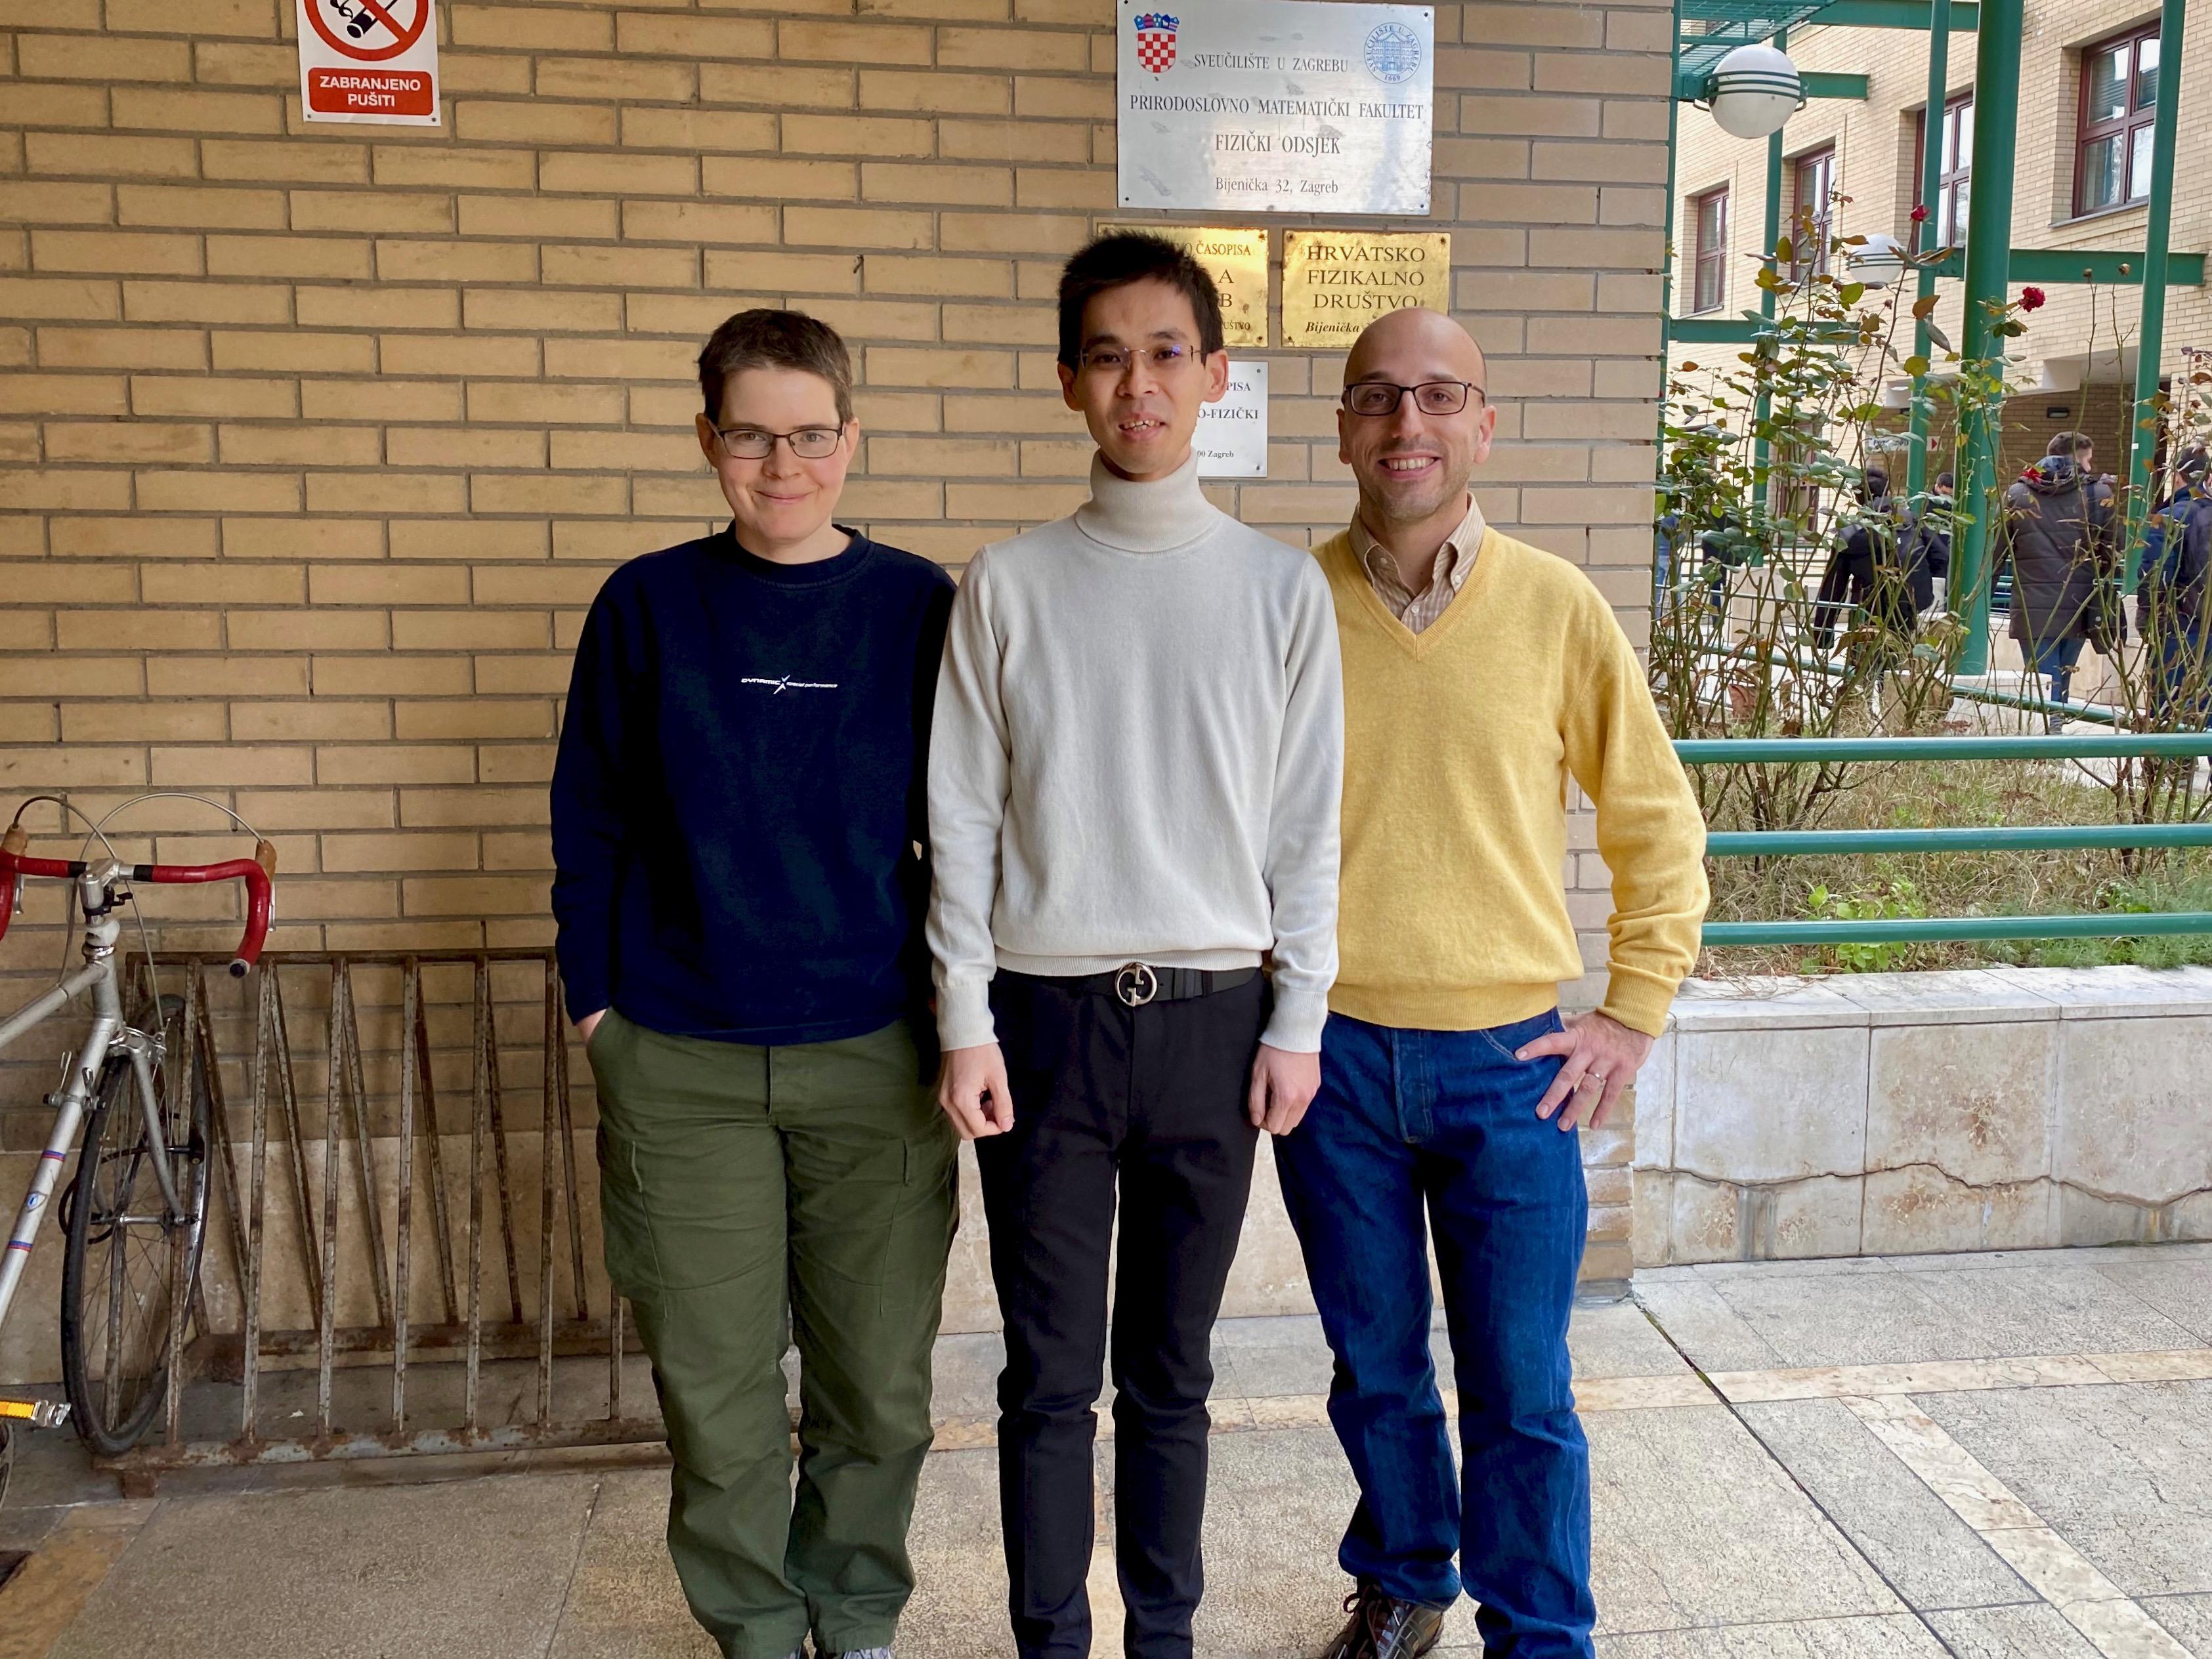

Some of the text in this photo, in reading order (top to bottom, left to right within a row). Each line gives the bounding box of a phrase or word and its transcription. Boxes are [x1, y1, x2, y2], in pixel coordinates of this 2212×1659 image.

[1195, 51, 1349, 73] SVEUČILIŠTE U ZAGREBU
[320, 76, 421, 91] ZABRANJENO
[348, 91, 395, 107] PUŠITI
[1130, 94, 1424, 119] PRIRODOSLOVNO MATEMATIČKI FAKULTET
[1216, 130, 1340, 158] FIZIČKI ODSJEK
[1216, 177, 1338, 196] Bijenička 32, Zagreb
[1196, 240, 1251, 256] ČASOPISA
[1306, 245, 1426, 262] HRVATSKO
[1307, 269, 1424, 286] FIZIKALNO
[1313, 290, 1418, 309] DRUŠTVO
[1222, 320, 1251, 331] UŠTVO
[1305, 321, 1360, 334] Bijenička
[1227, 382, 1251, 391] PISA
[1198, 406, 1259, 419] O-FIZIČKI
[1208, 450, 1234, 459] Zagreb
